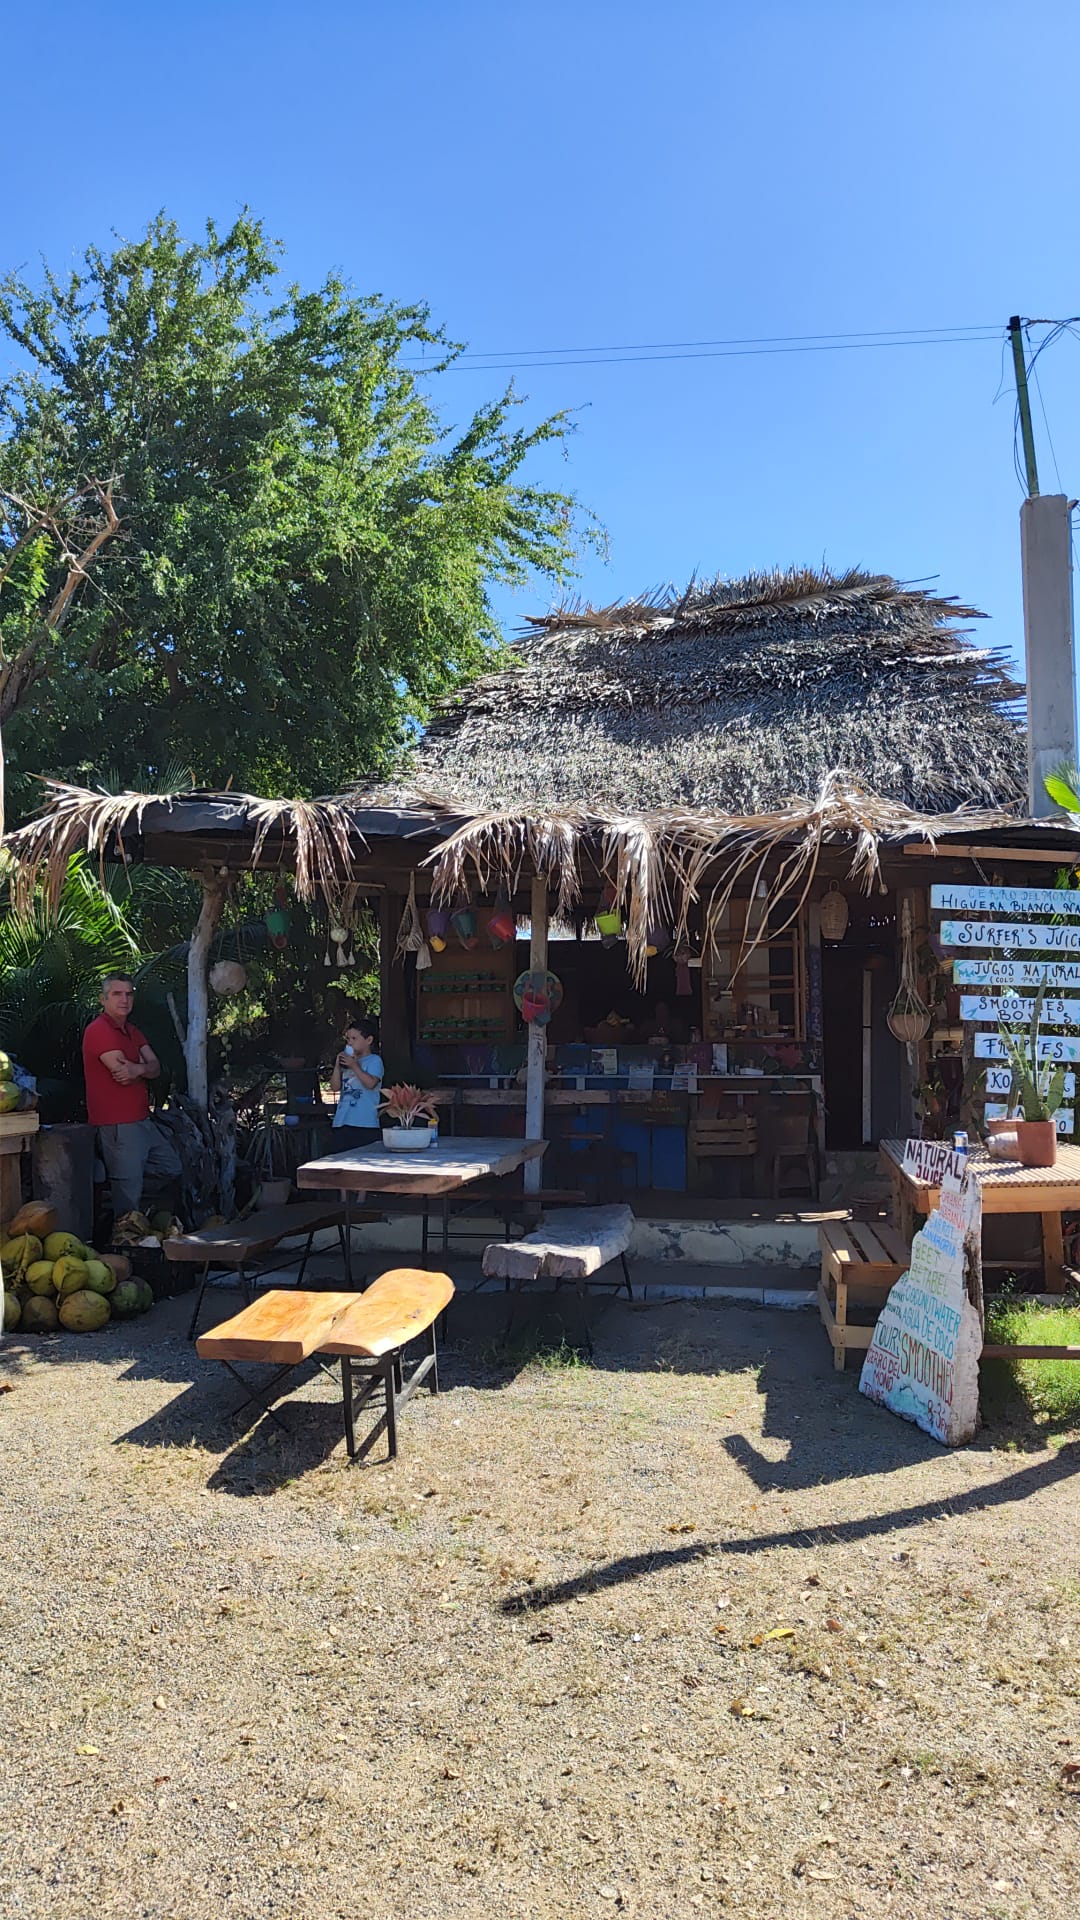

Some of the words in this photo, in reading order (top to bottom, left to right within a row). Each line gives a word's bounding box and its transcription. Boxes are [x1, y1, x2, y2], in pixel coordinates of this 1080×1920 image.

[941, 894, 1005, 909] HIGUERA
[1010, 900, 1056, 913] BLANCA
[968, 888, 1017, 899] CERRO
[958, 923, 1037, 947] SURFER'S
[974, 962, 1014, 976] JUGOS
[1020, 977, 1058, 987] PRES)
[979, 997, 1065, 1012] SMOOTHES
[906, 1140, 962, 1180] NATURAL
[916, 1164, 945, 1186] JUICE
[941, 1191, 967, 1213] ORANGE
[915, 1240, 942, 1264] BEET
[909, 1262, 948, 1297] BETABEL
[902, 1307, 920, 1333] AGUA
[921, 1315, 934, 1342] DE
[935, 1326, 954, 1361] COCO
[867, 1349, 888, 1371] CERRO
[888, 1360, 900, 1380] DEL
[901, 1333, 955, 1407] SMOOTHIES
[874, 1369, 894, 1392] MONO
